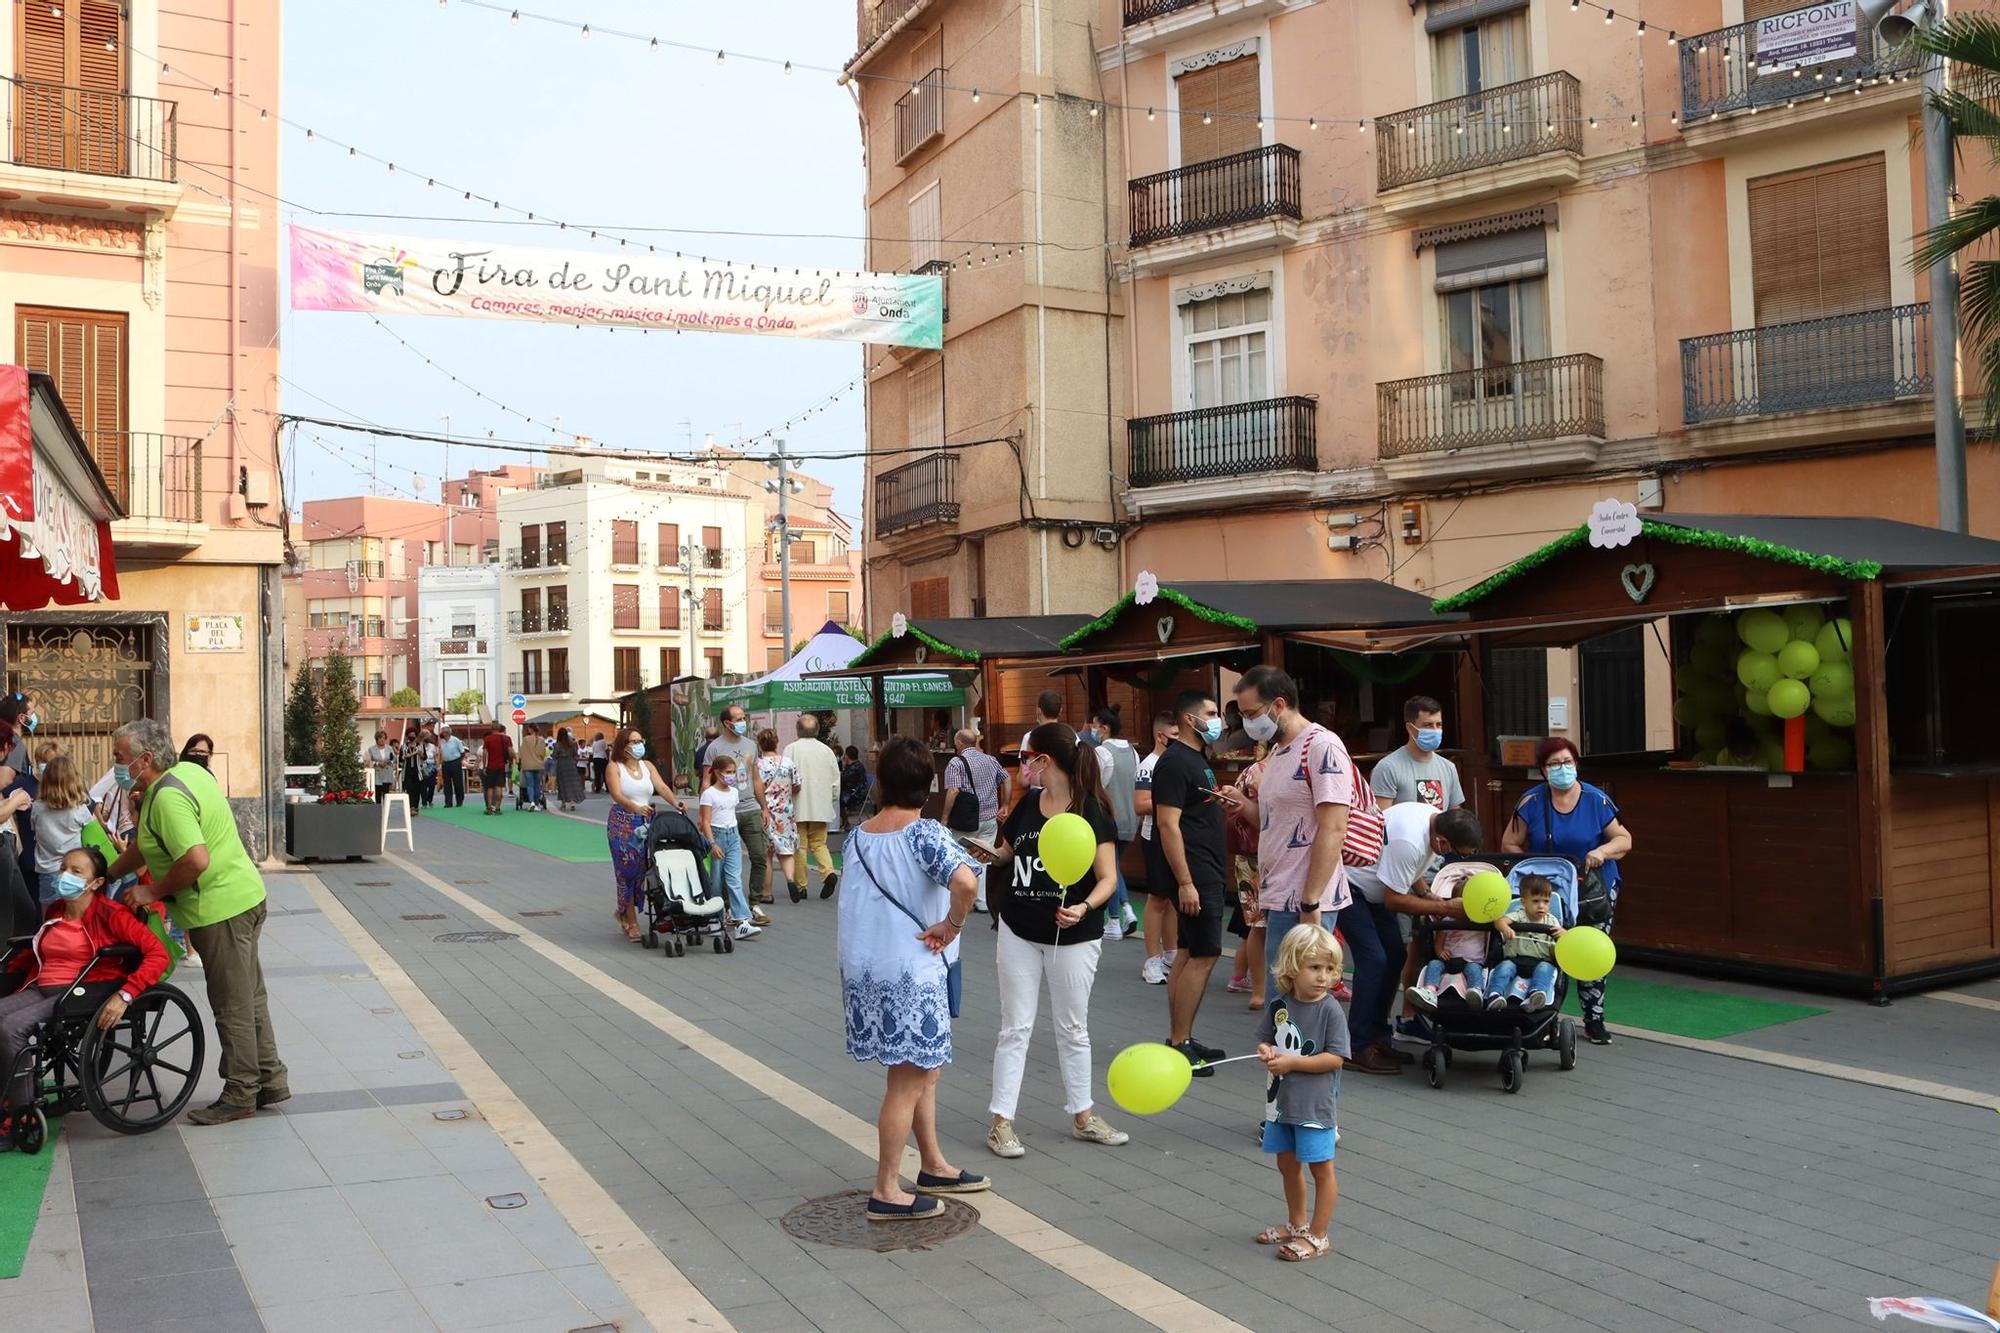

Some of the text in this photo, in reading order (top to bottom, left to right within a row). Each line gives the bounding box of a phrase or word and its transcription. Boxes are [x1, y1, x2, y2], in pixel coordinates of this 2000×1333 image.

[1763, 2, 1851, 34] RICFONT
[432, 250, 539, 296] Fira
[549, 261, 593, 291] de
[602, 264, 692, 298] Sant
[880, 306, 910, 318] Onda
[676, 311, 709, 325] molt
[713, 312, 741, 326] més
[744, 317, 753, 328] a
[211, 629, 224, 637] DEL
[208, 637, 224, 645] PLA
[833, 680, 873, 692] CASTELLO
[884, 681, 911, 692] ONTRA
[912, 682, 922, 692] EL
